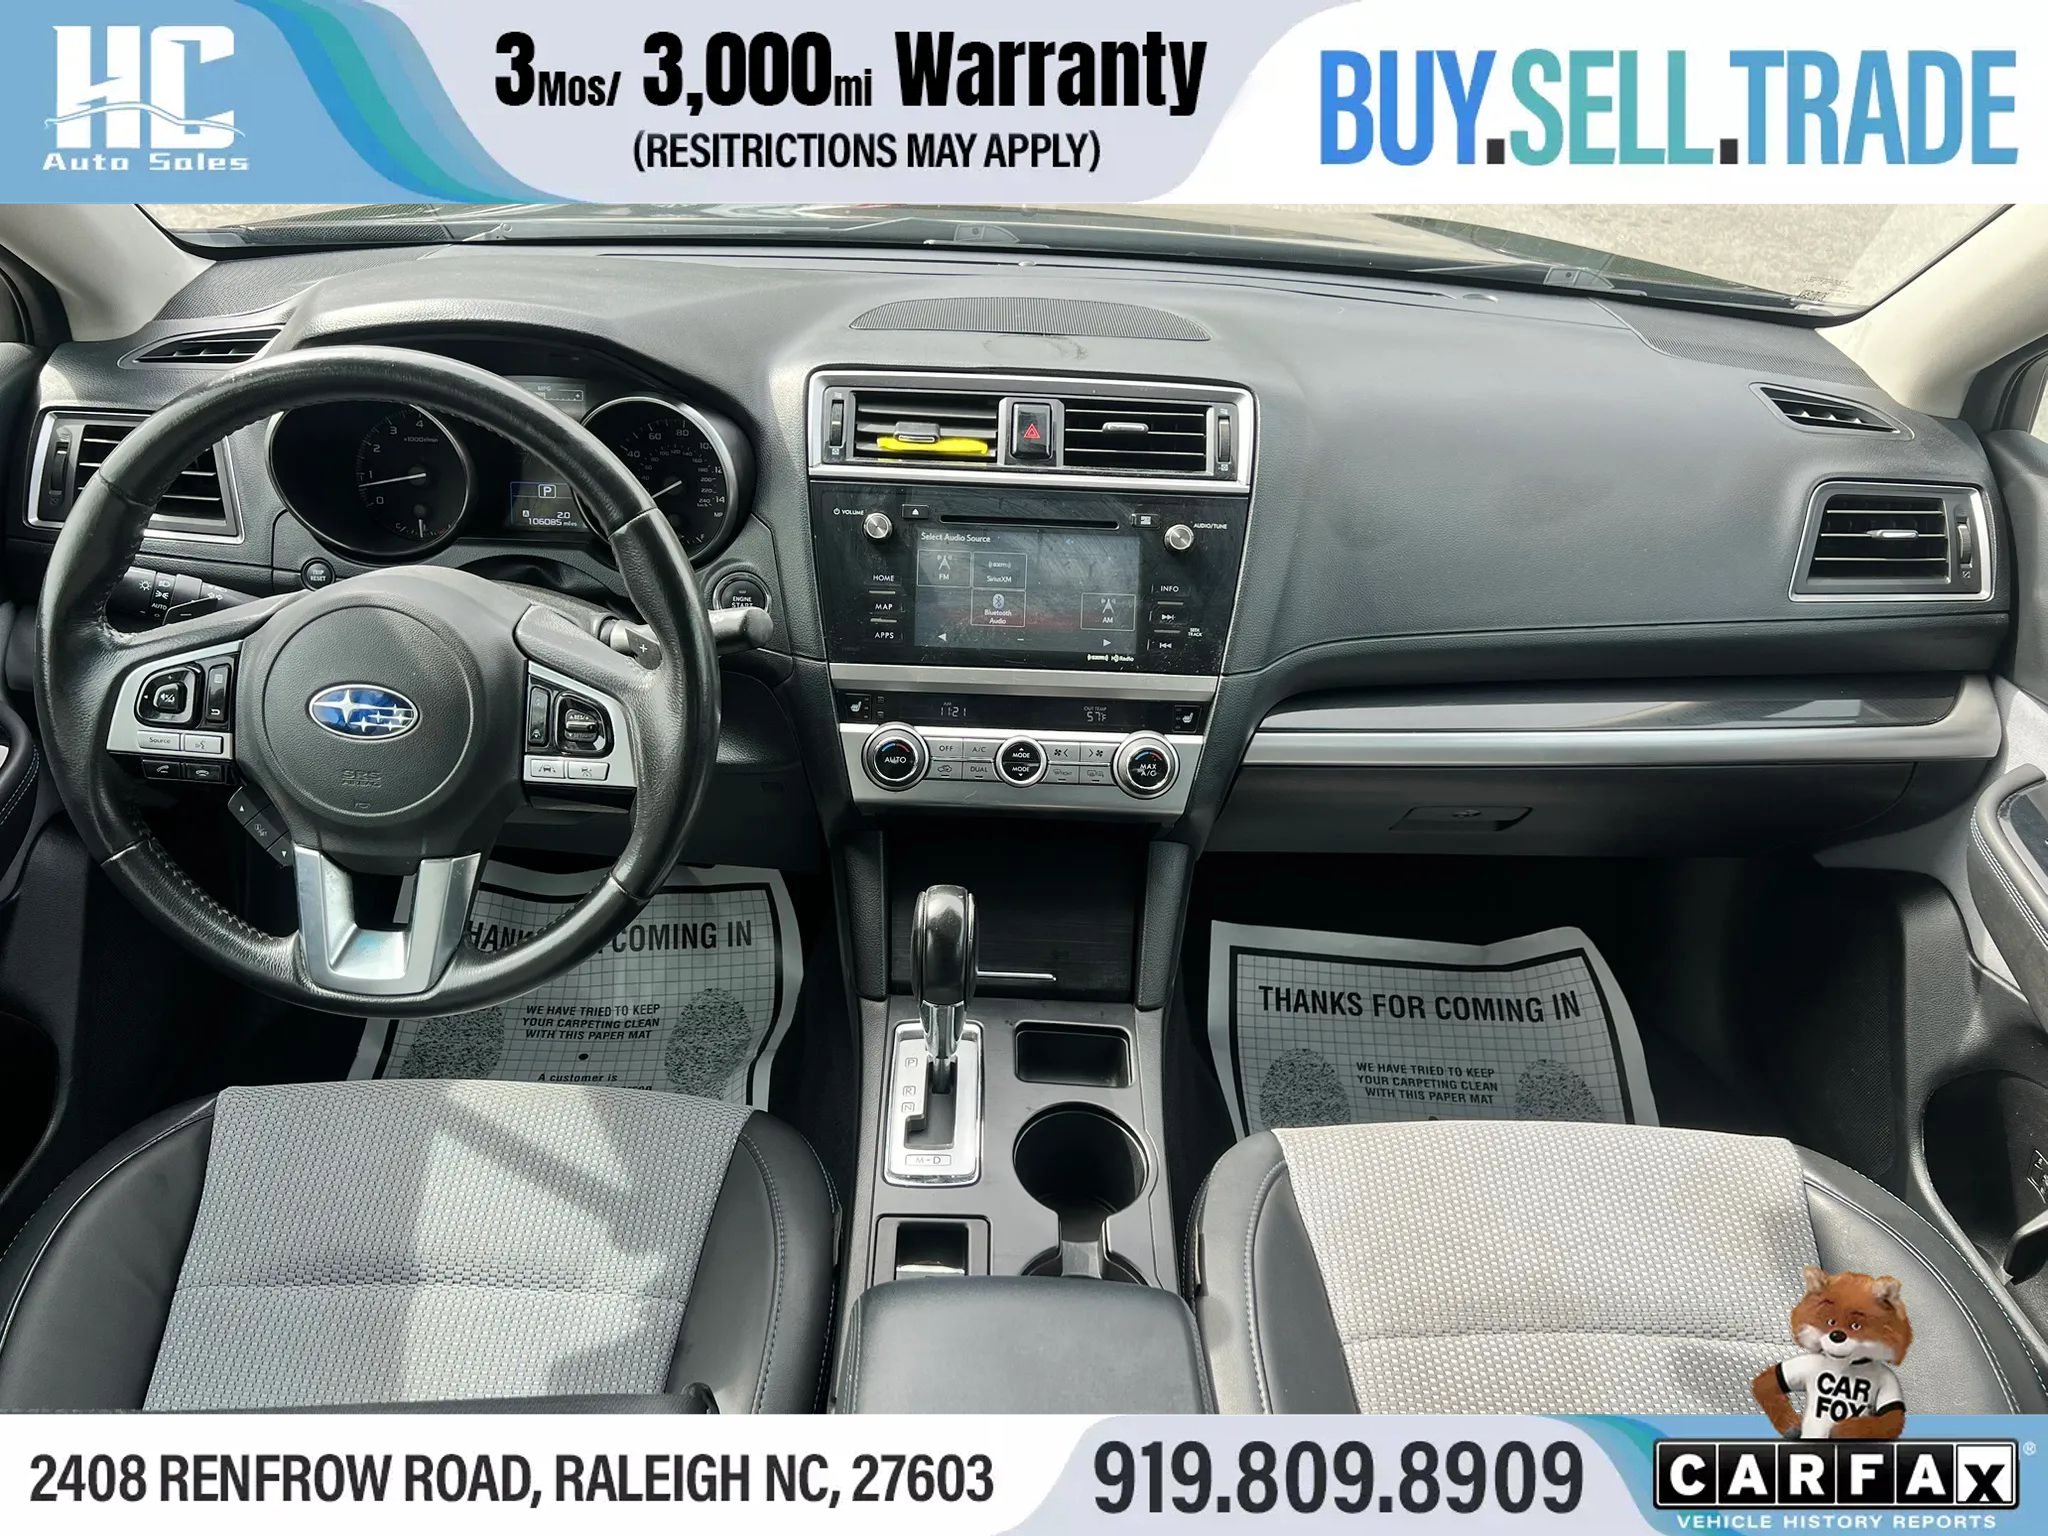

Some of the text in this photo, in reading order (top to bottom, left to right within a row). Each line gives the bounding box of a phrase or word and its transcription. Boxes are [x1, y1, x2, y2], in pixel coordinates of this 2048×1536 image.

[676, 429, 689, 437] 80
[373, 444, 381, 452] 2
[627, 450, 641, 458] 40
[543, 486, 552, 497] P
[528, 518, 562, 526] 106085
[921, 532, 943, 541] Select
[944, 534, 965, 542] Audio
[873, 574, 895, 582] HOME
[152, 602, 168, 610] AUTO
[989, 617, 1007, 625] Audio
[149, 736, 171, 744] Source
[612, 921, 717, 952] COMING
[728, 920, 752, 947] IN
[1258, 985, 1581, 1022] THANKS FOR COMING IN
[526, 1004, 661, 1017] WE HAVE TRIED TO KEEP
[522, 1017, 660, 1029] YOUR CARPETING CLEAN
[525, 1029, 653, 1040] WITH THIS PAPER MAT
[1356, 1062, 1495, 1078] WE HAVE TRIED TO KEEP
[537, 1073, 618, 1082] A customer is
[1356, 1075, 1498, 1092] YOUR CARPETING CLEAN
[1365, 1087, 1494, 1104] WITH THIS PAPER MAT
